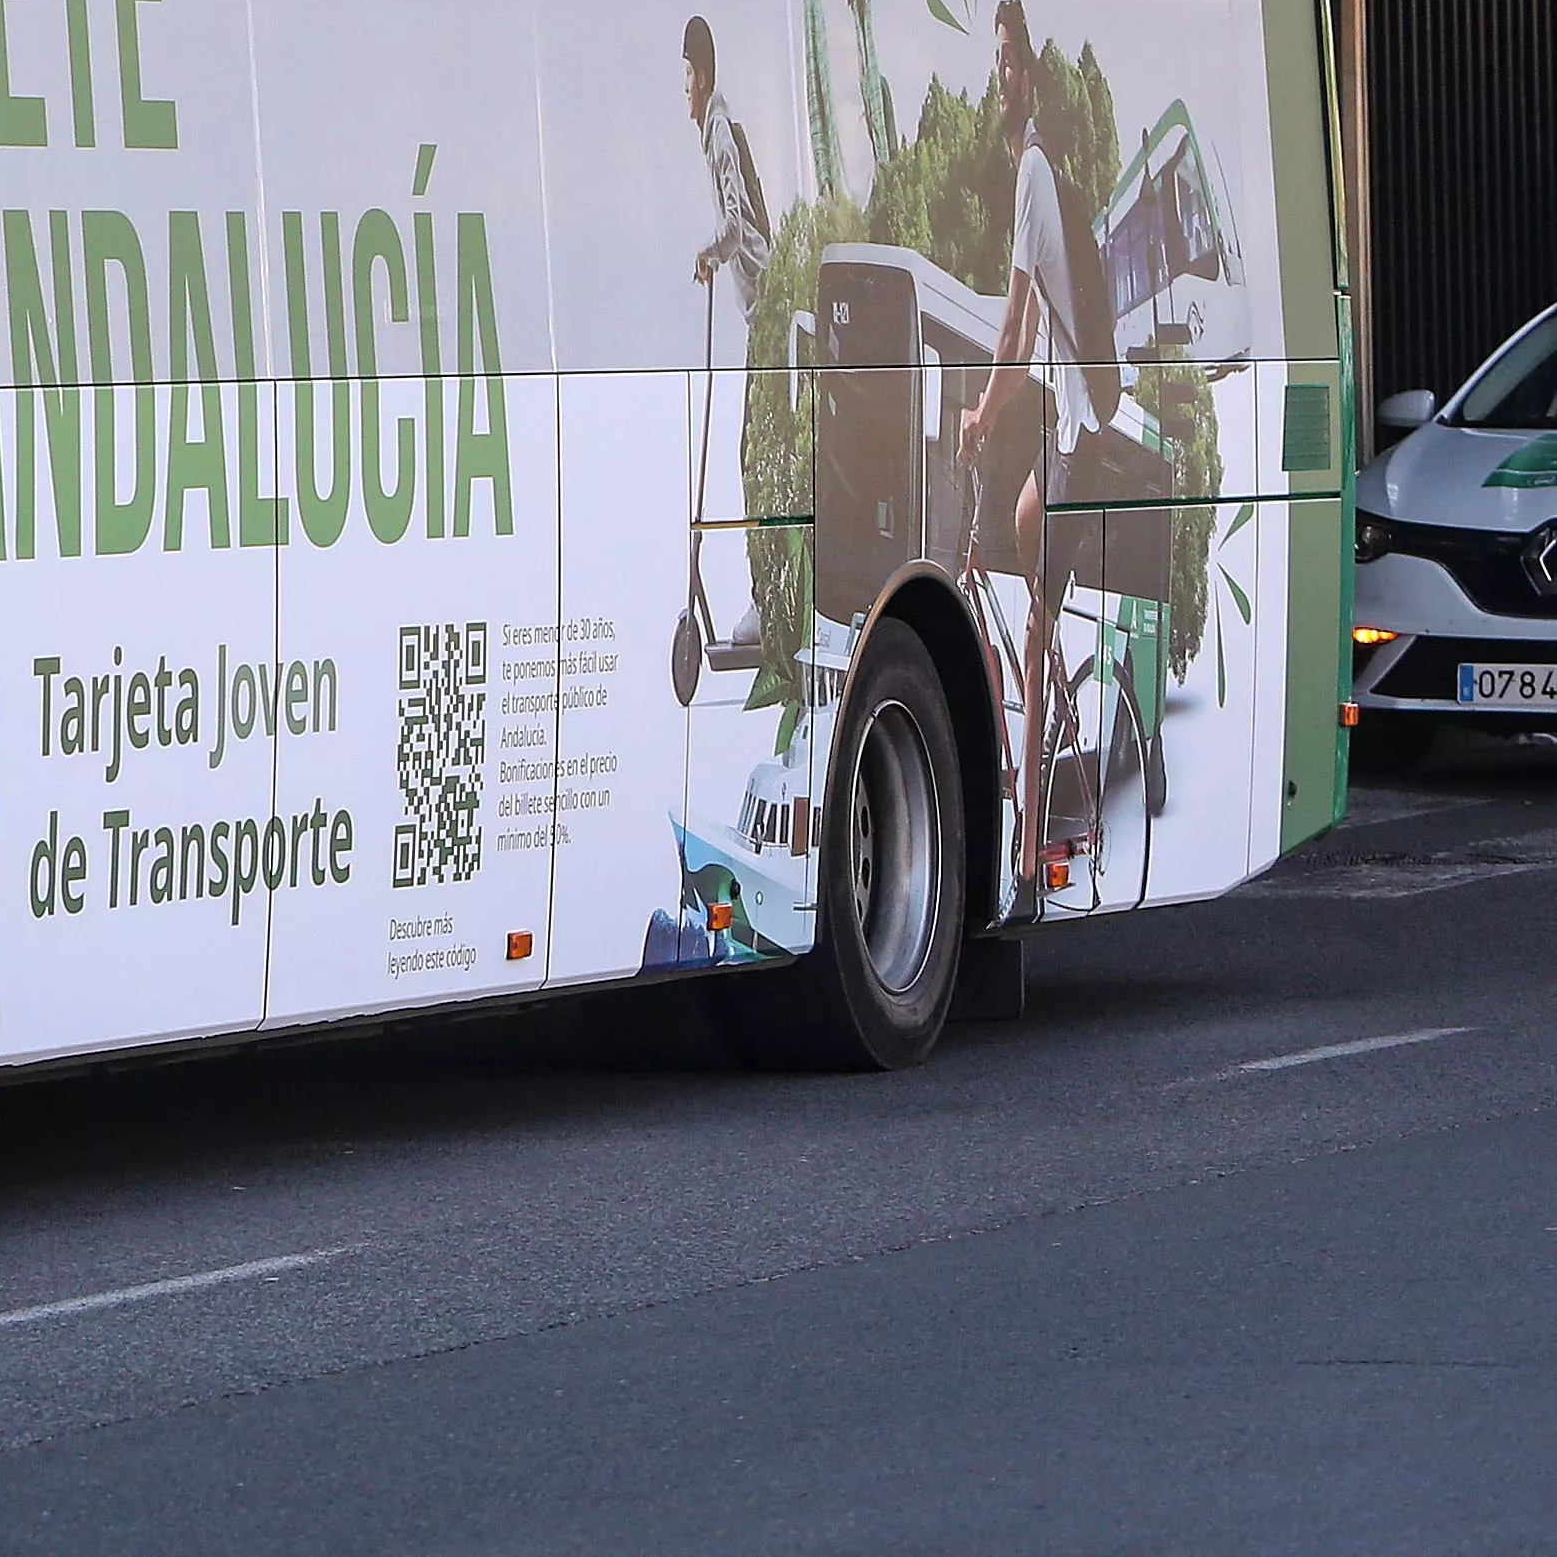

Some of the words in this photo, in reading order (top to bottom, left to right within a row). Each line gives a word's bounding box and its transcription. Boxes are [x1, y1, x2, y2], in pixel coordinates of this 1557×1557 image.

[513, 627, 532, 645] eres
[534, 625, 565, 644] menor
[567, 619, 578, 641] de
[580, 618, 591, 640] 30
[592, 616, 616, 641] años,
[502, 660, 511, 680] te
[513, 660, 556, 686] ponemos
[559, 652, 577, 675] más
[579, 651, 597, 674] fácil
[599, 654, 618, 673] usar
[1479, 669, 1557, 700] 0784
[34, 645, 199, 783] Tarjeta
[209, 644, 337, 769] Joven
[502, 691, 510, 715] el
[512, 692, 559, 719] transporte
[561, 686, 595, 716] público
[596, 684, 608, 706] de
[500, 723, 547, 749] Andalucía.
[500, 758, 565, 783] Bonificaciones
[567, 759, 578, 776] en
[580, 753, 589, 775] el
[589, 751, 617, 781] precio
[499, 794, 513, 817] del
[515, 793, 542, 815] billete
[544, 788, 579, 814] sencillo
[580, 791, 596, 808] con
[598, 789, 610, 807] un
[497, 828, 532, 852] mínimo
[534, 824, 547, 847] del
[29, 810, 86, 917] de
[103, 798, 353, 926] Transporte
[389, 915, 432, 941] Descubre
[434, 911, 453, 935] más
[388, 948, 424, 980] leyendo
[425, 948, 444, 970] este
[447, 944, 476, 971] código
